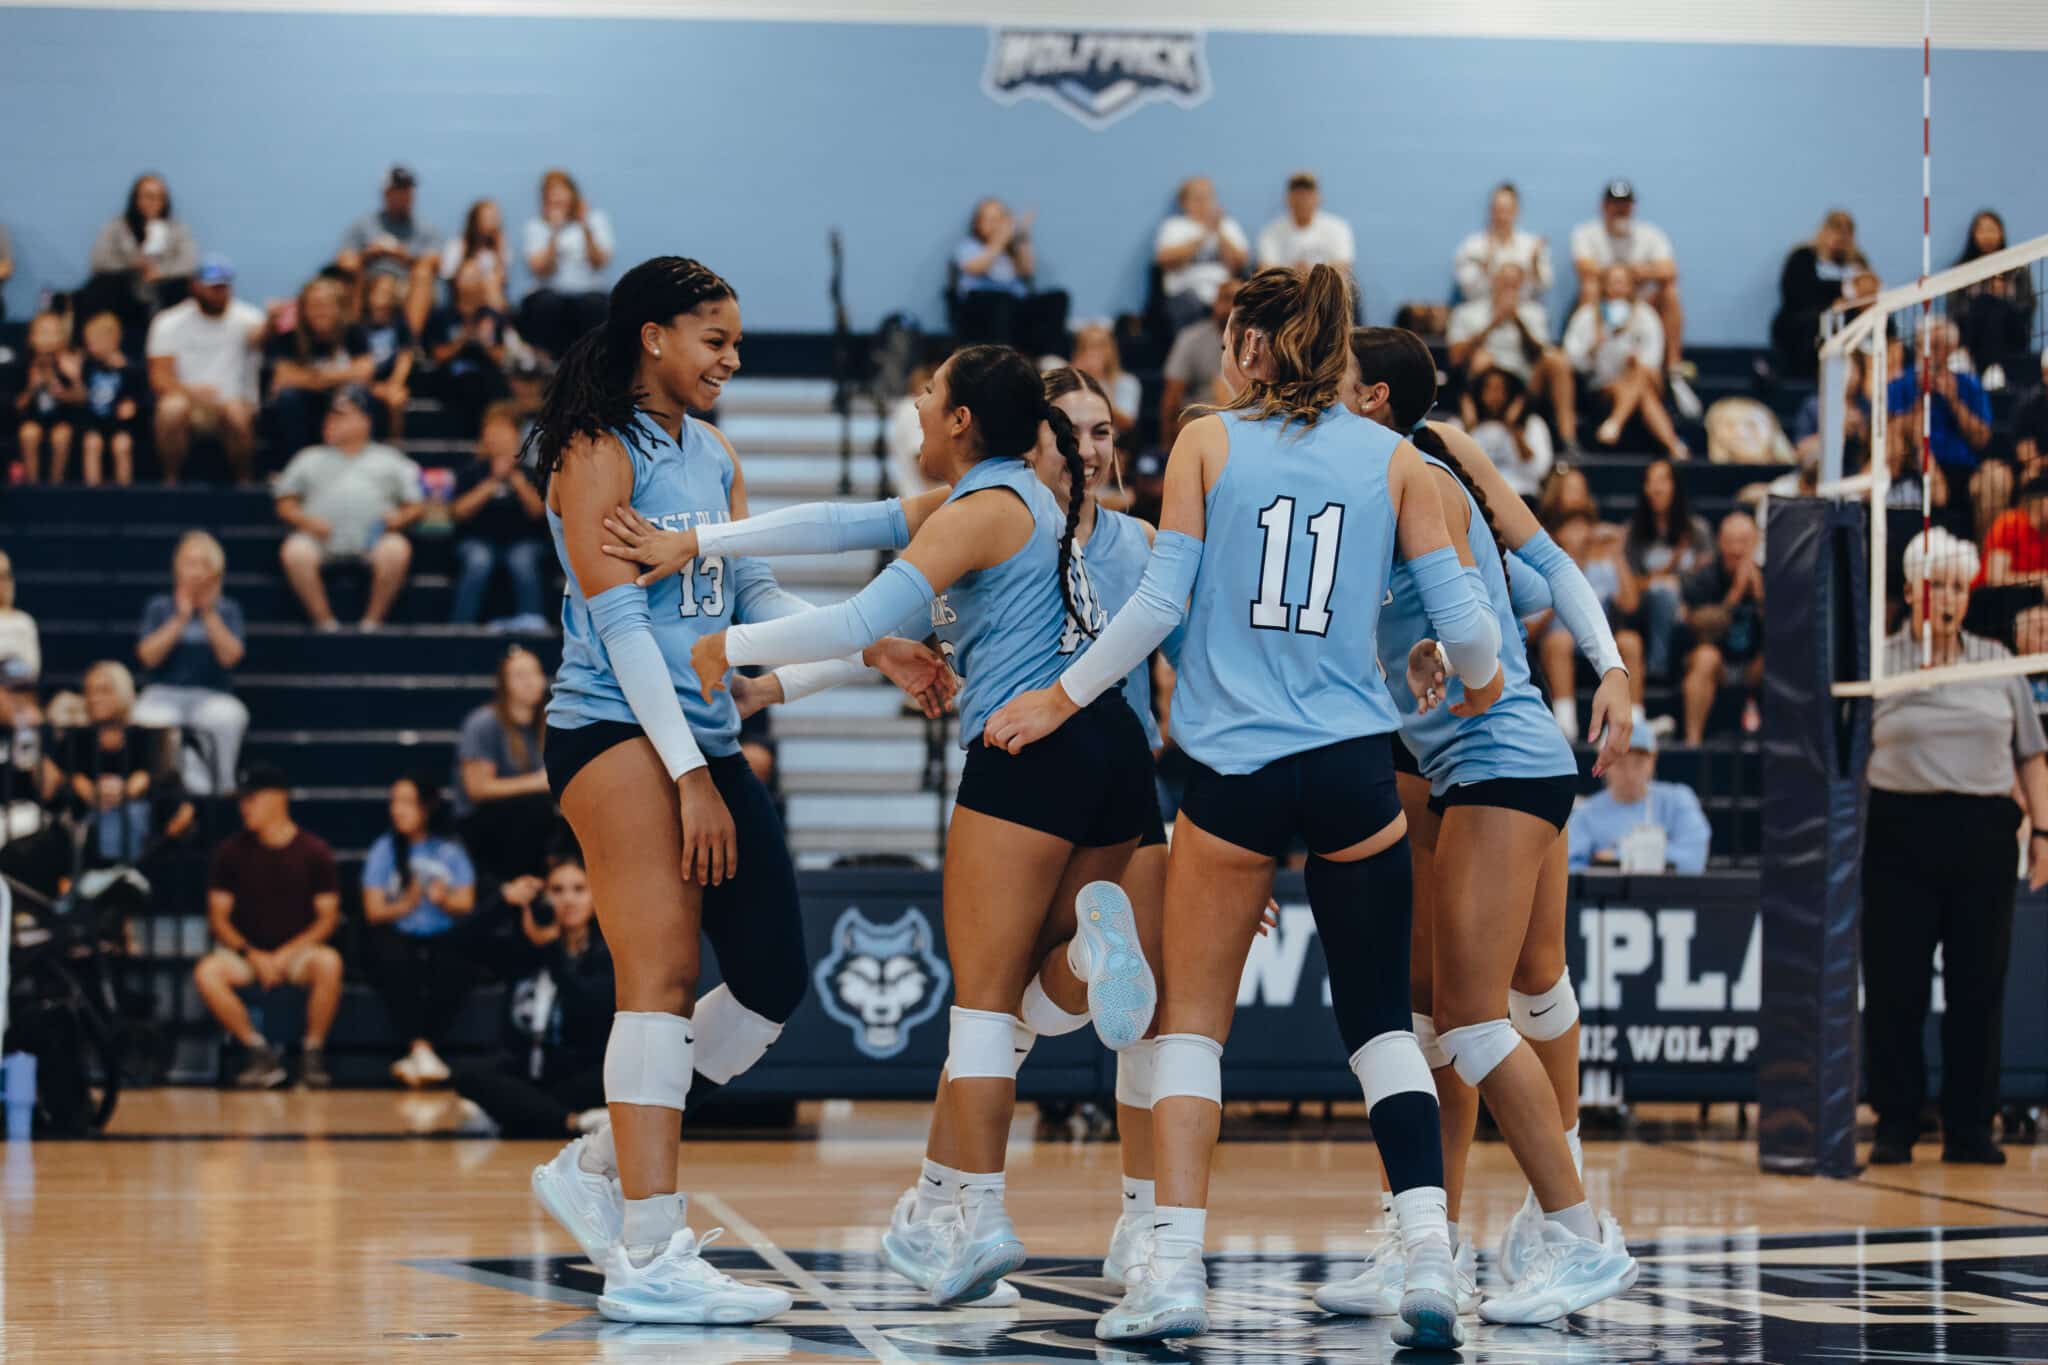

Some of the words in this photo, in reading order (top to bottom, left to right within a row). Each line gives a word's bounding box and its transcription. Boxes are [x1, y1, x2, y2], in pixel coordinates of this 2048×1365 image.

[679, 556, 726, 618] 13
[1250, 495, 1345, 638] 11
[1626, 1026, 1760, 1063] WOLFP
